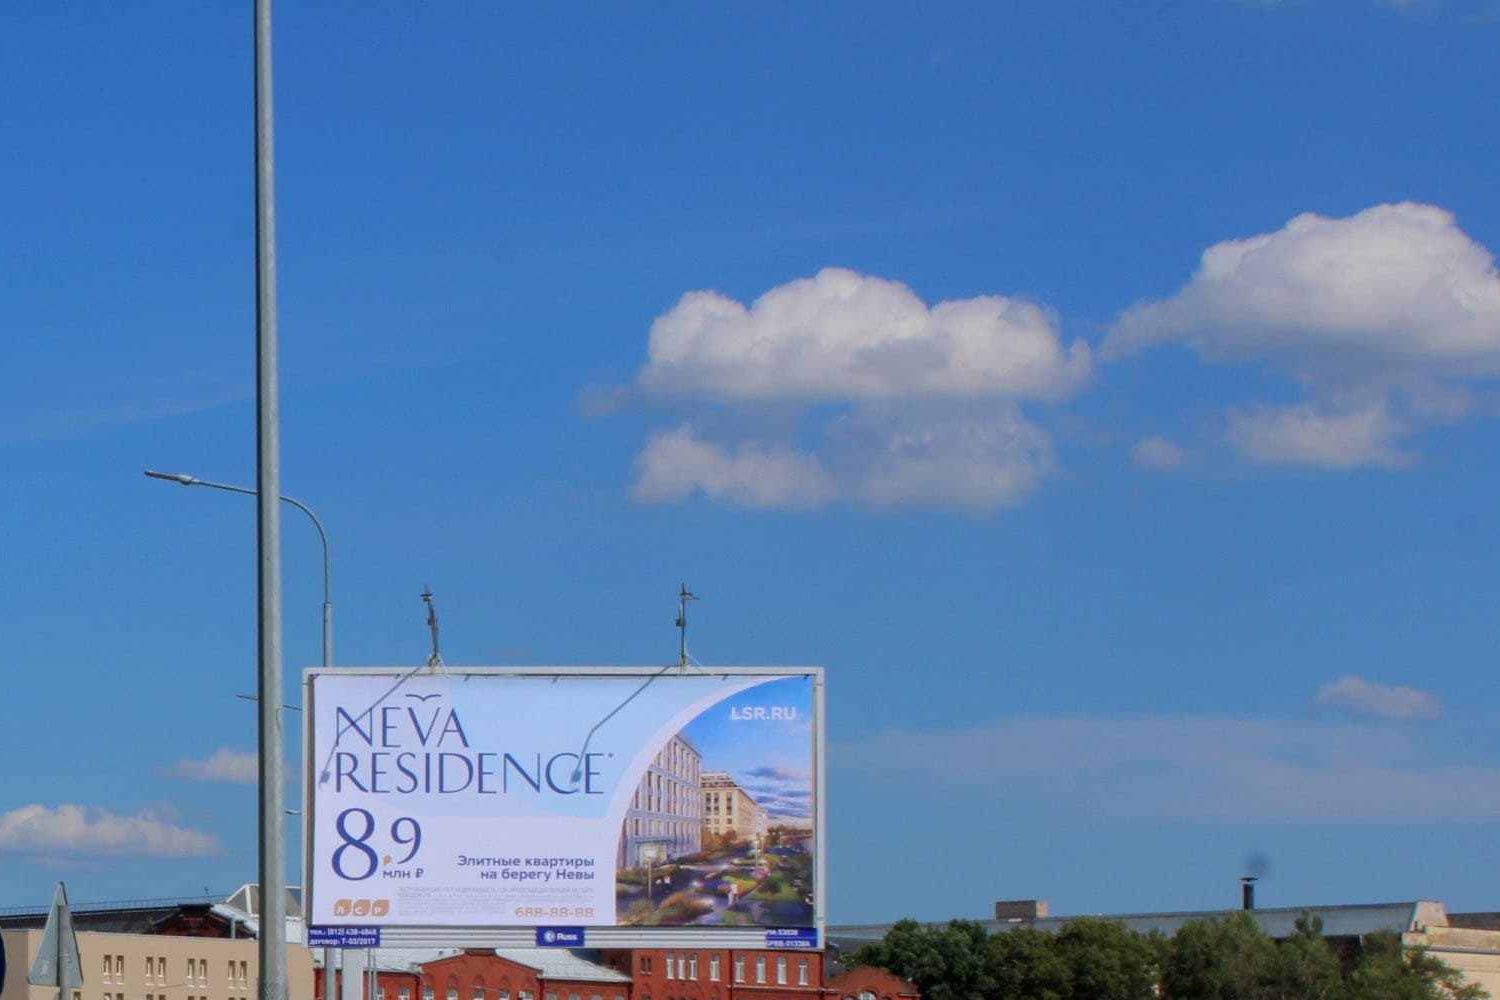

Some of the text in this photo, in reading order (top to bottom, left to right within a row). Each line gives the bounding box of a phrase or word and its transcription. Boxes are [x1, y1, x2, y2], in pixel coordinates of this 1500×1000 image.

[730, 706, 797, 720] LSR.RU
[335, 706, 469, 748] NEVA
[457, 855, 595, 869] Элитные квартиры
[382, 868, 411, 879] млн
[480, 868, 595, 881] на берегу Невы
[334, 903, 386, 916] ЛСР
[514, 907, 594, 918] 688-88-88
[556, 932, 578, 941] Russ
